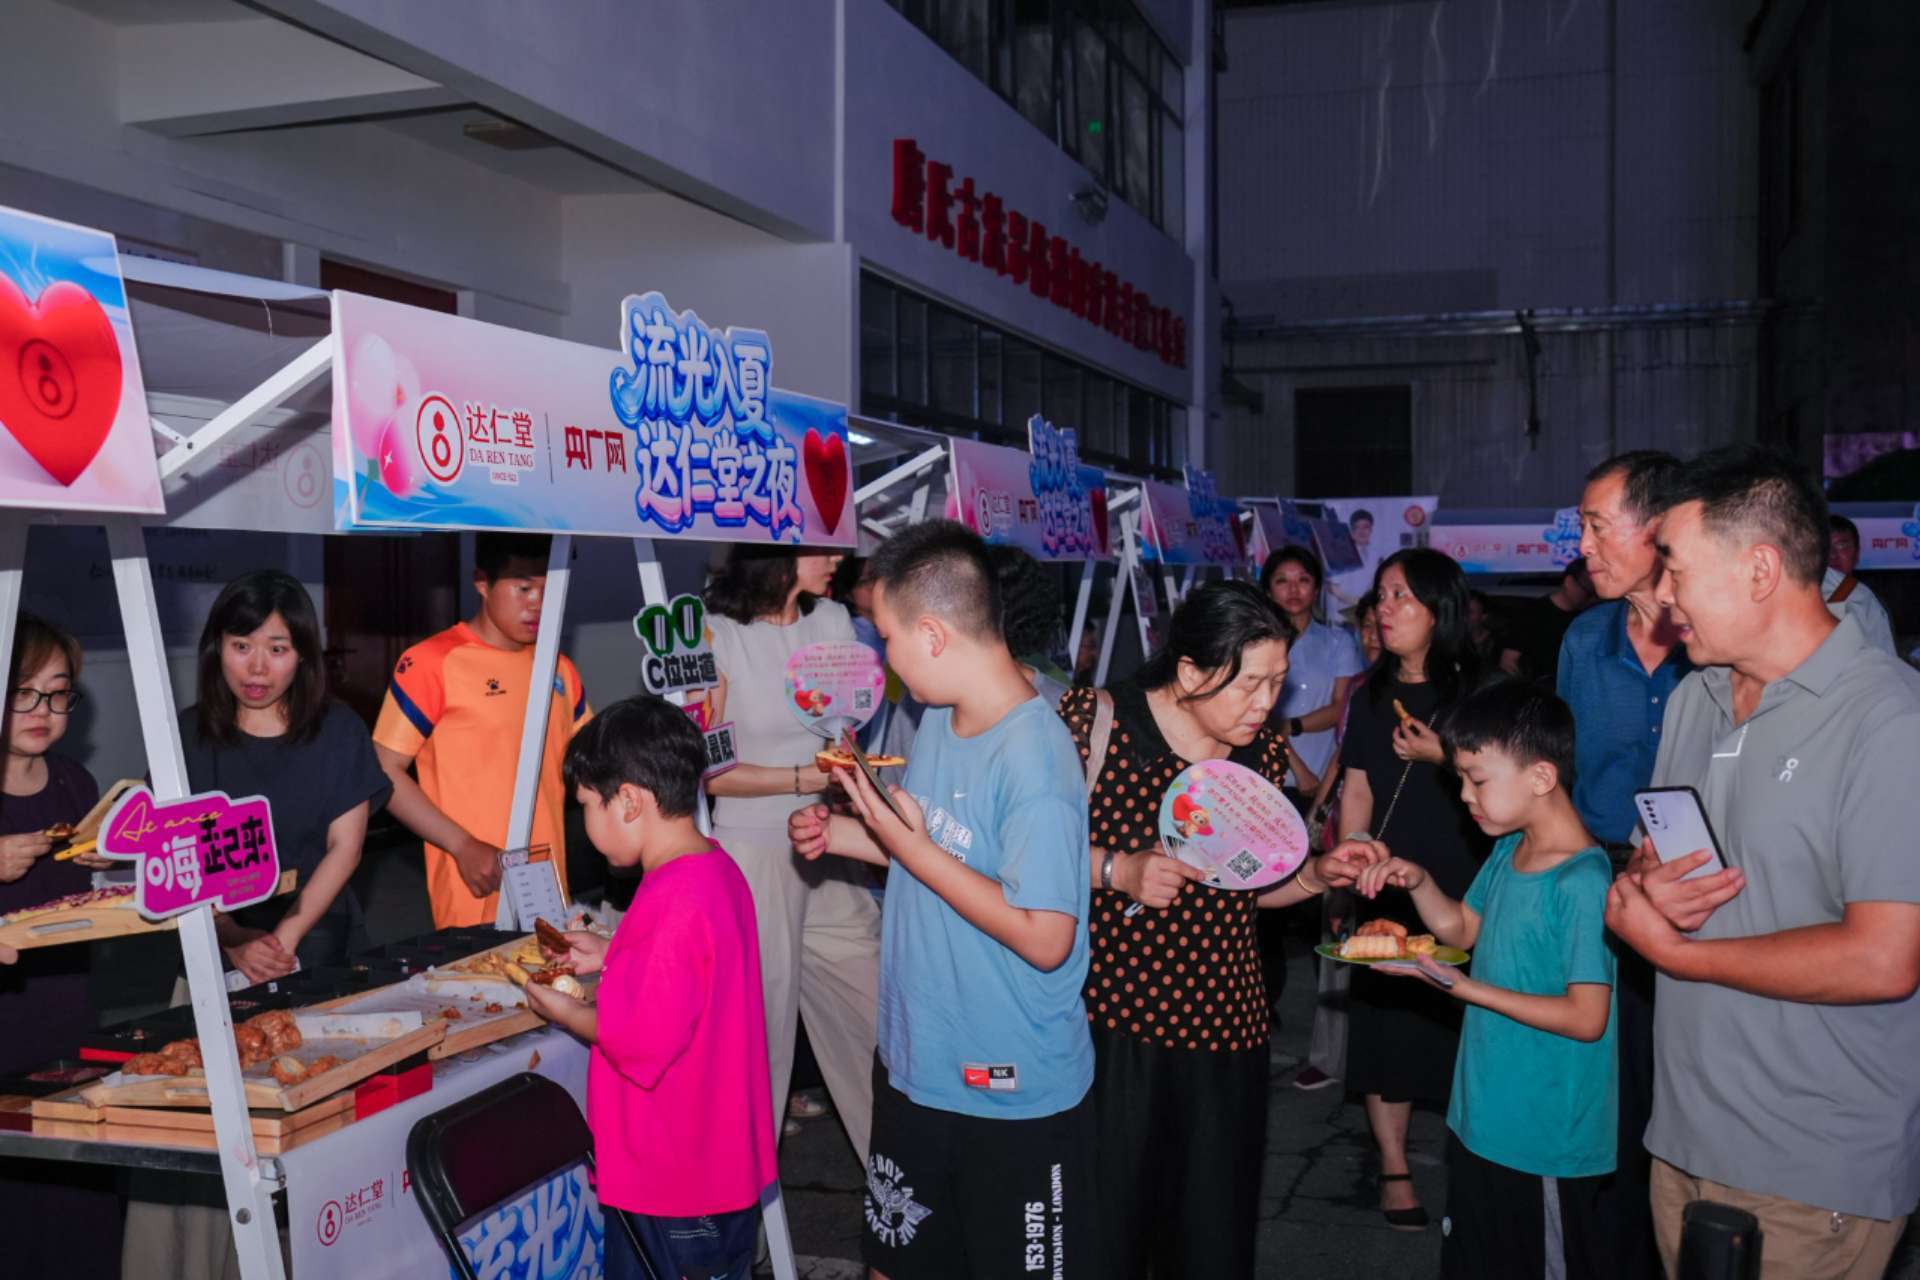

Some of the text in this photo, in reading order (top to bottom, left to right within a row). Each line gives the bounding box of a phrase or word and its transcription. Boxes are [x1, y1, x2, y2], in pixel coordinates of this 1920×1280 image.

[611, 306, 774, 436] 流光入夏
[466, 405, 534, 449] 达仁堂
[469, 448, 534, 468] DA REN TANG
[564, 426, 627, 474] 央广网
[636, 416, 802, 532] 达仁堂之夜
[648, 652, 717, 689] C位出道
[993, 1067, 1008, 1077] NK
[345, 1179, 384, 1214] 达仁堂
[1051, 1163, 1063, 1213] LONDON
